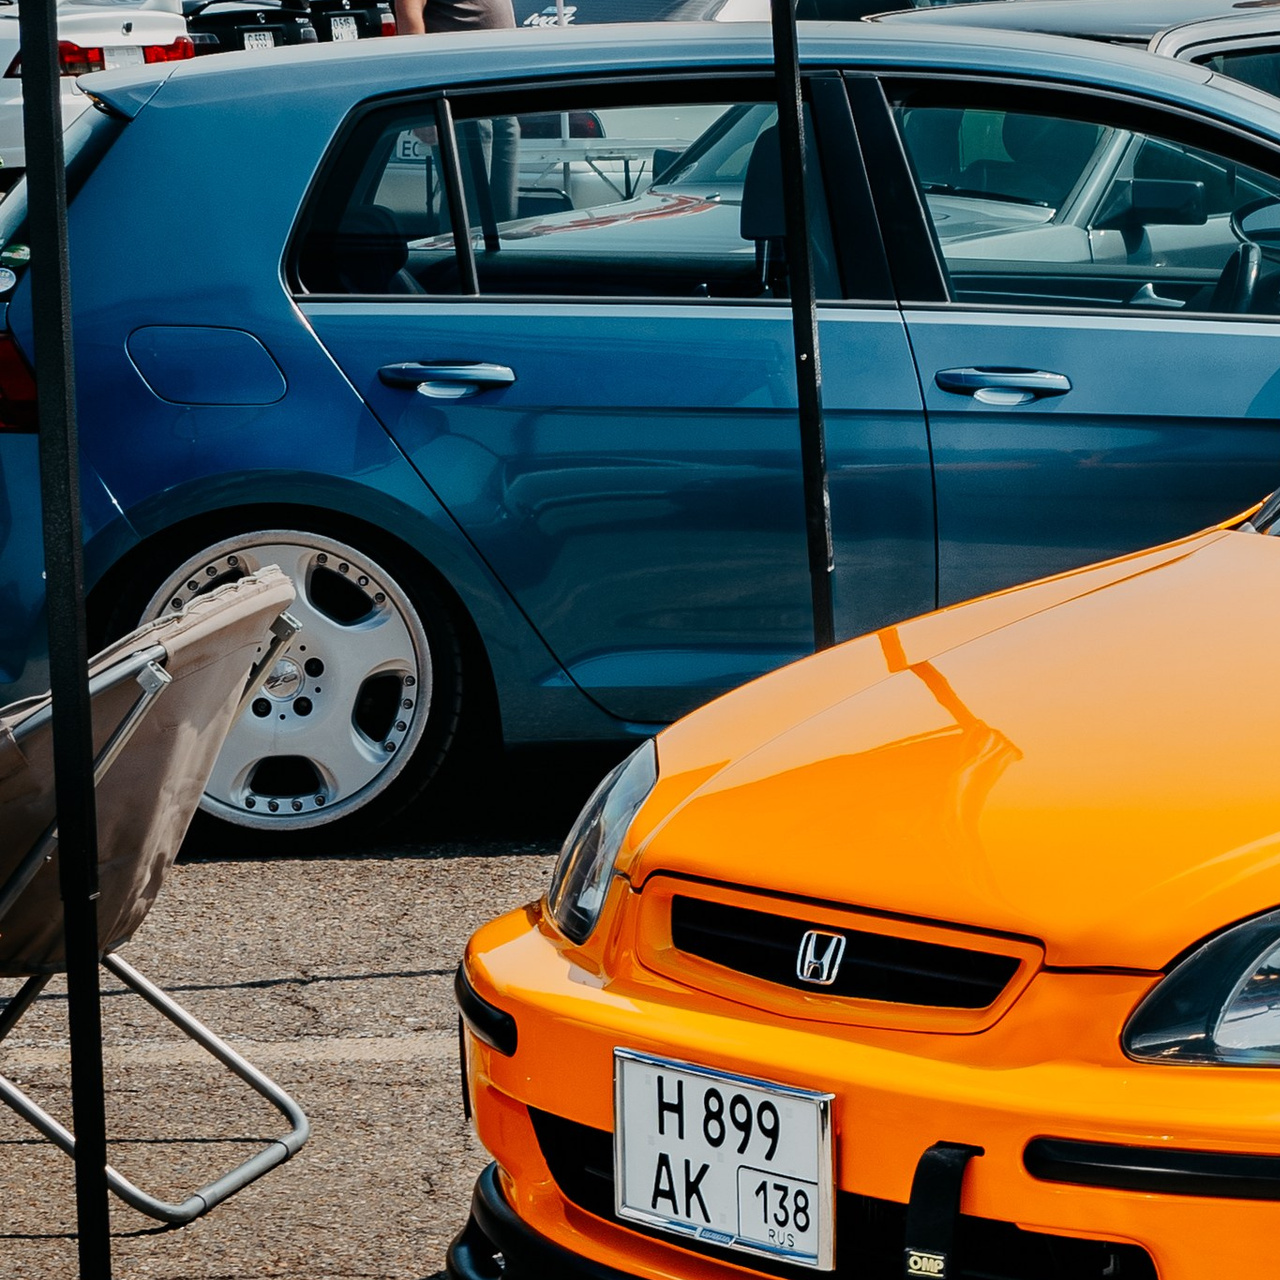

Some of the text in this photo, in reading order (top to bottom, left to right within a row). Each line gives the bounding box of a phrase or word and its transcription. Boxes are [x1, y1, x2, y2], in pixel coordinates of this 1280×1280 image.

[703, 1087, 780, 1161] 899
[755, 1180, 810, 1232] 138
[768, 1228, 795, 1247] RUS
[909, 1255, 944, 1273] OMP
